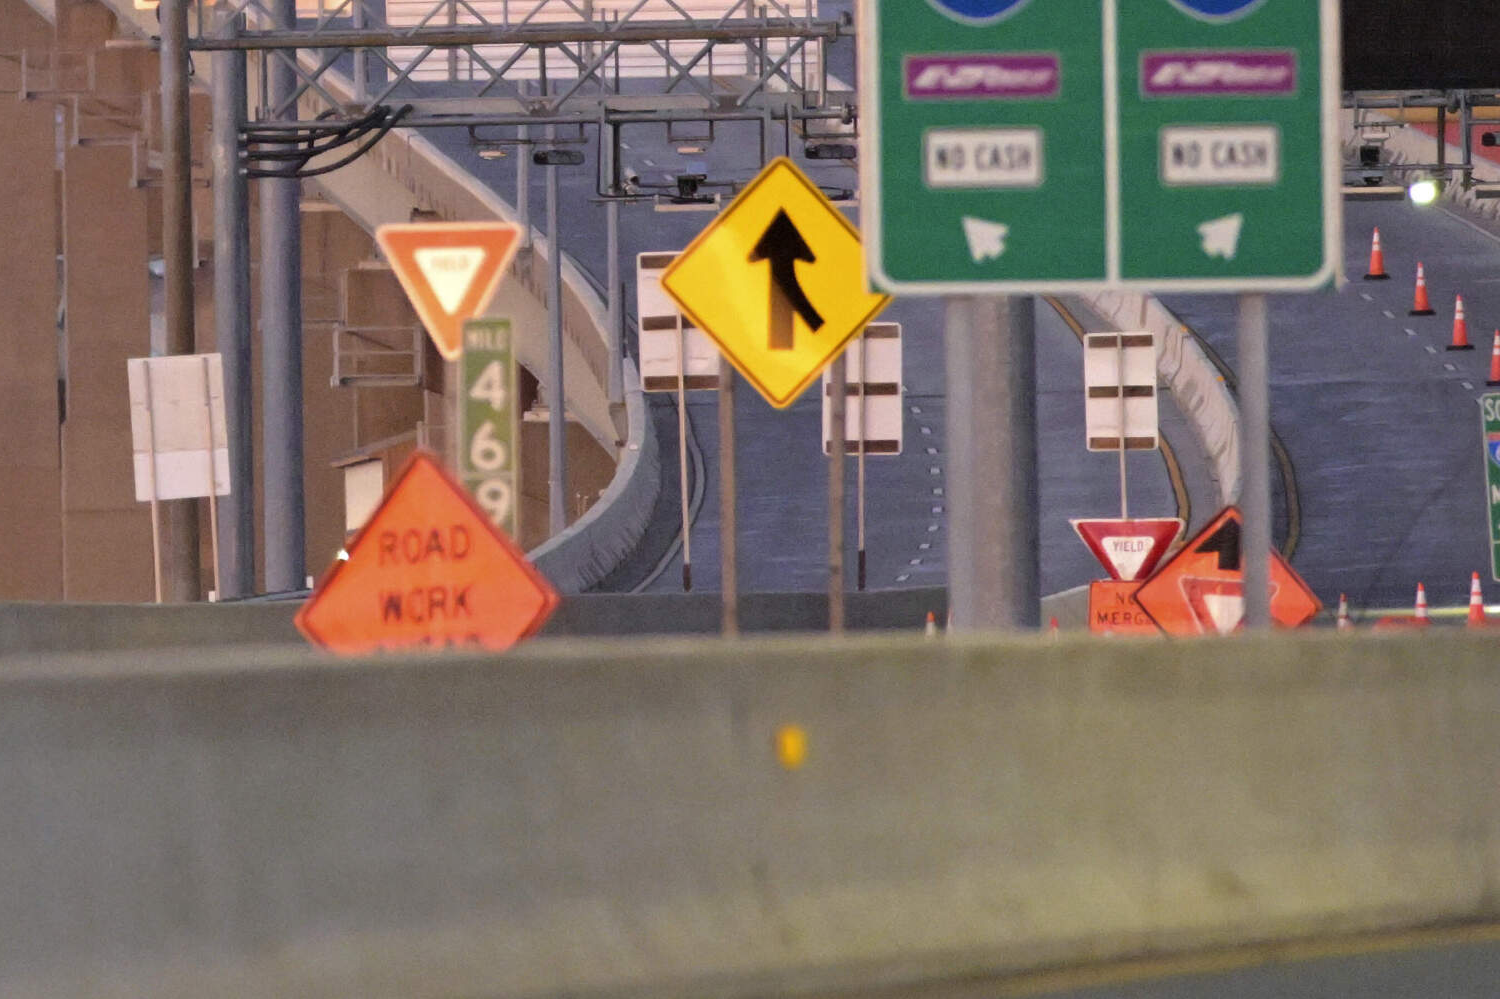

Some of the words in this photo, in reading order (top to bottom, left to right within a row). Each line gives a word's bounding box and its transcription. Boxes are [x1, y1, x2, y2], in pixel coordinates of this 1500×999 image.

[935, 147, 966, 169] NO
[974, 144, 1032, 170] CASH
[1172, 144, 1201, 167] NO
[1211, 141, 1268, 168] CASH
[378, 525, 471, 565] ROAD
[1113, 541, 1144, 552] YIELD
[379, 586, 475, 624] WORK
